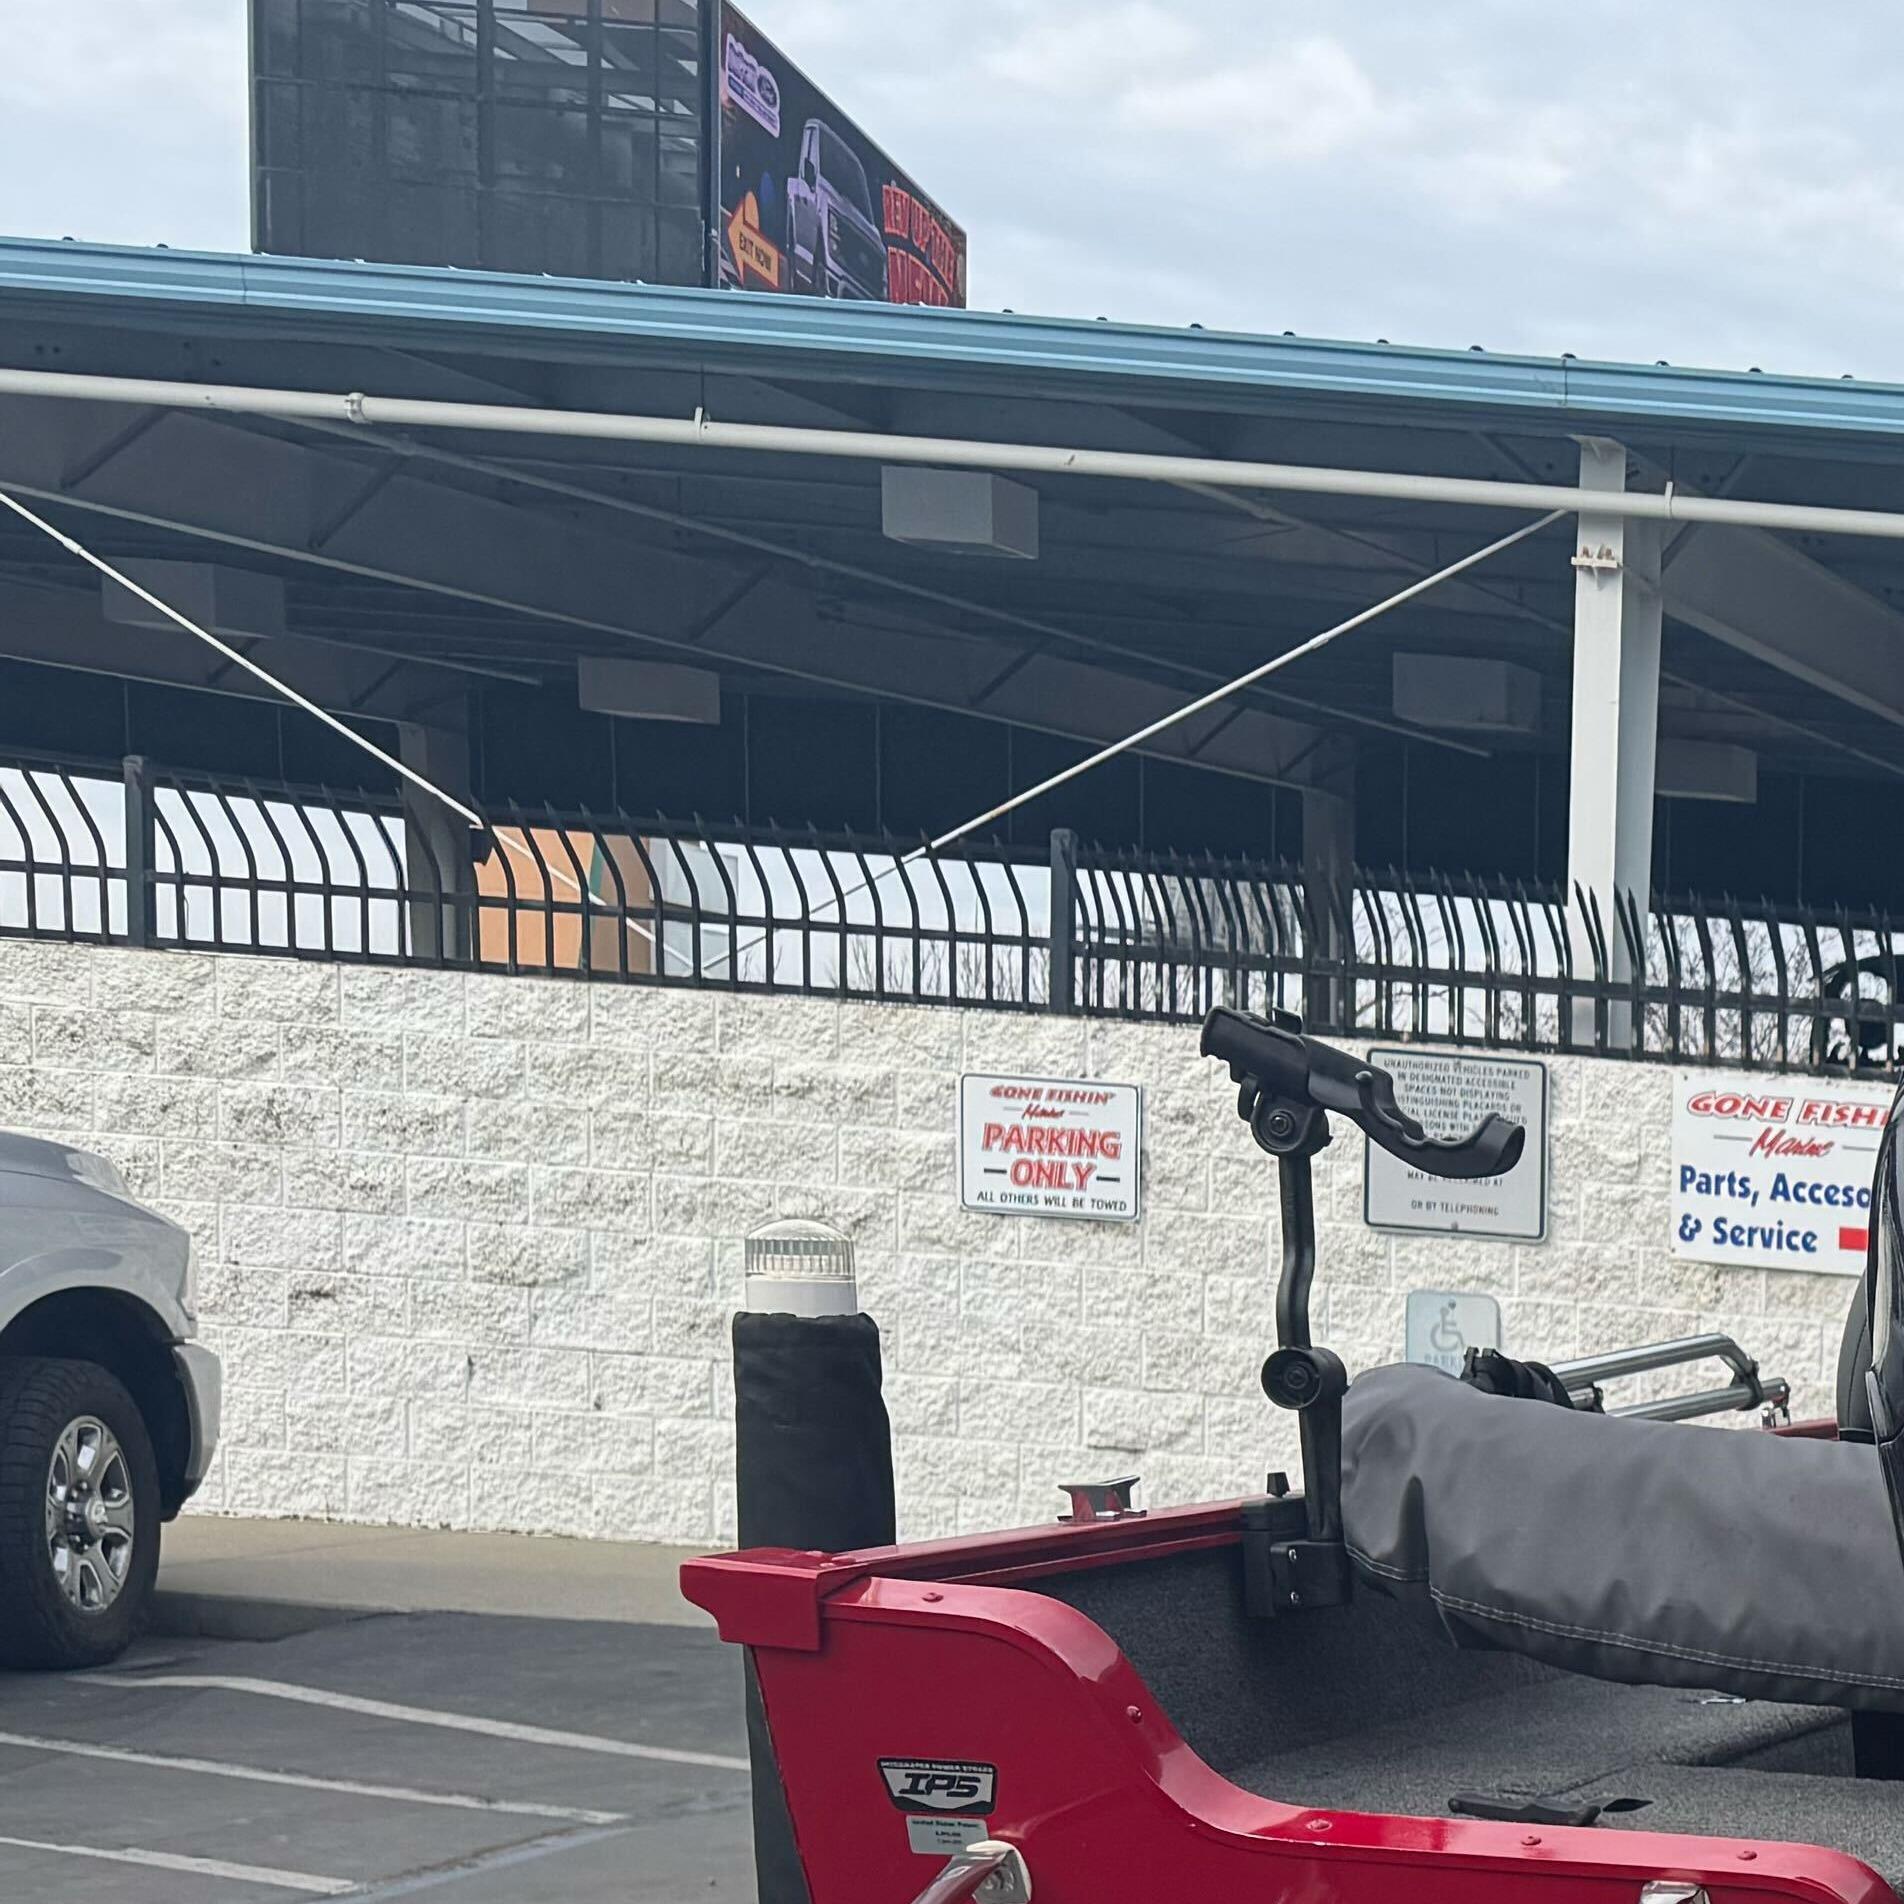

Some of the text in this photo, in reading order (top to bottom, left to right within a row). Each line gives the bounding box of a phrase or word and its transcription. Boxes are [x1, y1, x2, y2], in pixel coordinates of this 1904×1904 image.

[1384, 1060, 1531, 1079] UNAUTHORIZED VEHICLES PARKED
[1398, 1072, 1515, 1090] IN DESIGNATED ACCESSIBLE
[990, 1084, 1044, 1101] GONE
[1405, 1084, 1510, 1101] SPACES NOT DISPLAYING
[1423, 1108, 1458, 1120] LICENSE
[1463, 1099, 1506, 1112] PLACARDS
[1510, 1103, 1522, 1113] OR
[1687, 1090, 1794, 1123] GONE
[982, 1122, 1122, 1160] PARKING
[1749, 1125, 1835, 1159] Marine
[1010, 1158, 1097, 1192] ONLY
[1680, 1164, 1759, 1208] Parts,
[977, 1191, 1128, 1213] ALL OTHERS WILL BE TOWED
[1411, 1199, 1423, 1210] OR
[1440, 1202, 1499, 1217] TELEPHONING
[1678, 1213, 1818, 1253] & Service
[899, 1773, 981, 1798] IPS
